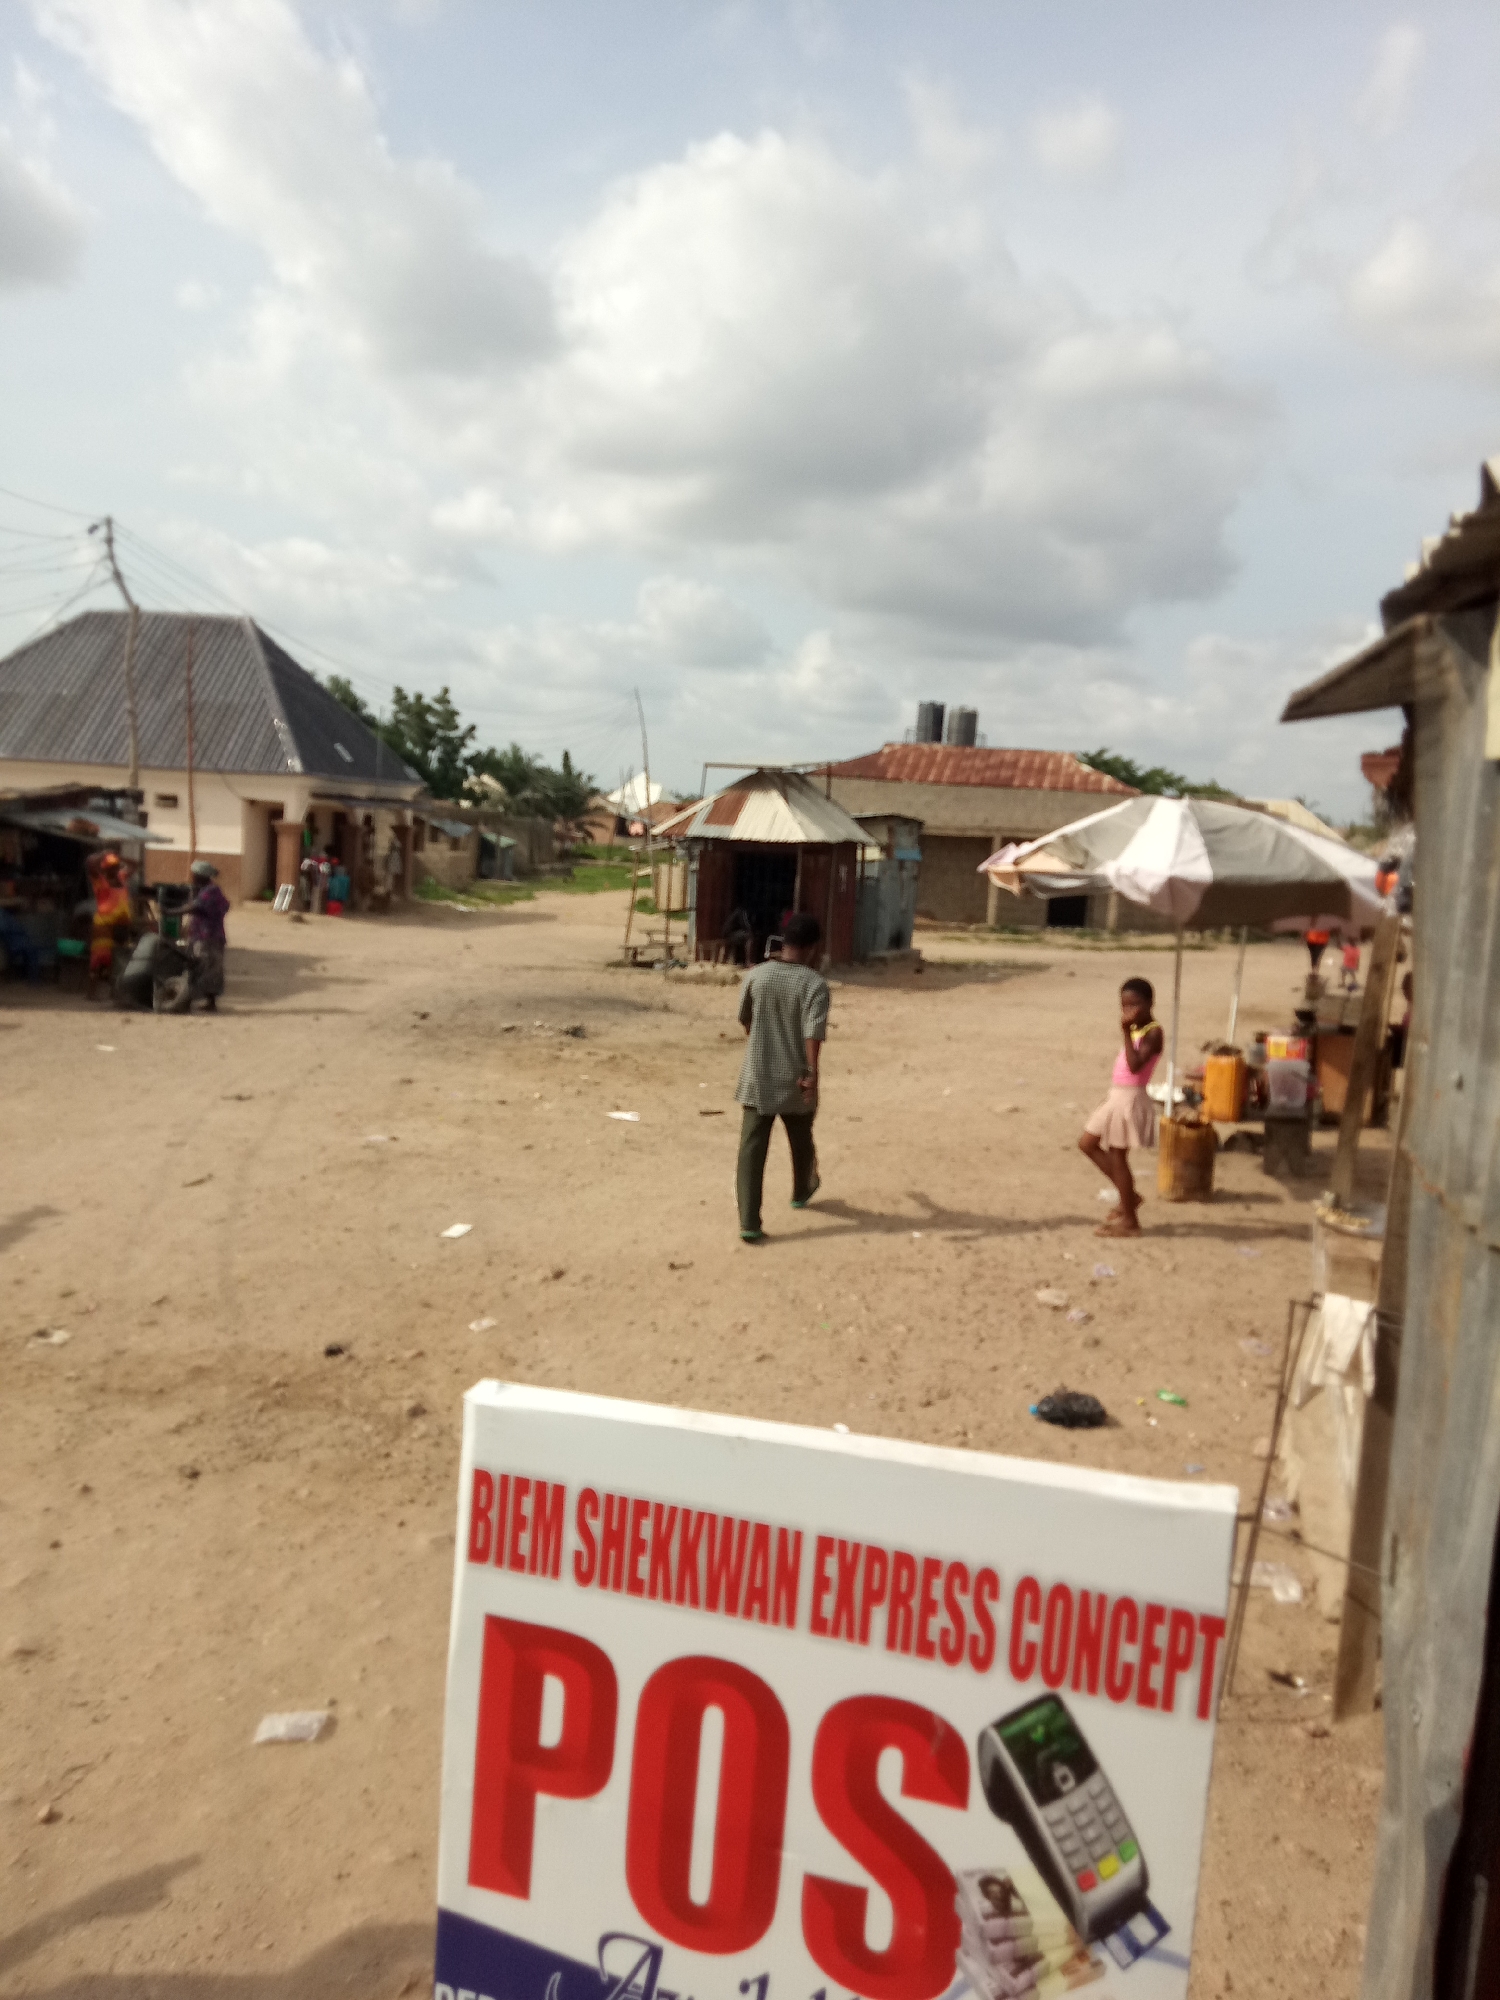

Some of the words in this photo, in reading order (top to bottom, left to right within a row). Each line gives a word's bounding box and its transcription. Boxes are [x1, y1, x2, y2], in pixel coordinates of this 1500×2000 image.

[468, 1468, 566, 1580] BIEM
[573, 1487, 803, 1630] SHEKKWAN
[810, 1535, 1000, 1674] EXPRESS
[1009, 1576, 1226, 1720] CONCEPT
[467, 1615, 971, 2000] POS
